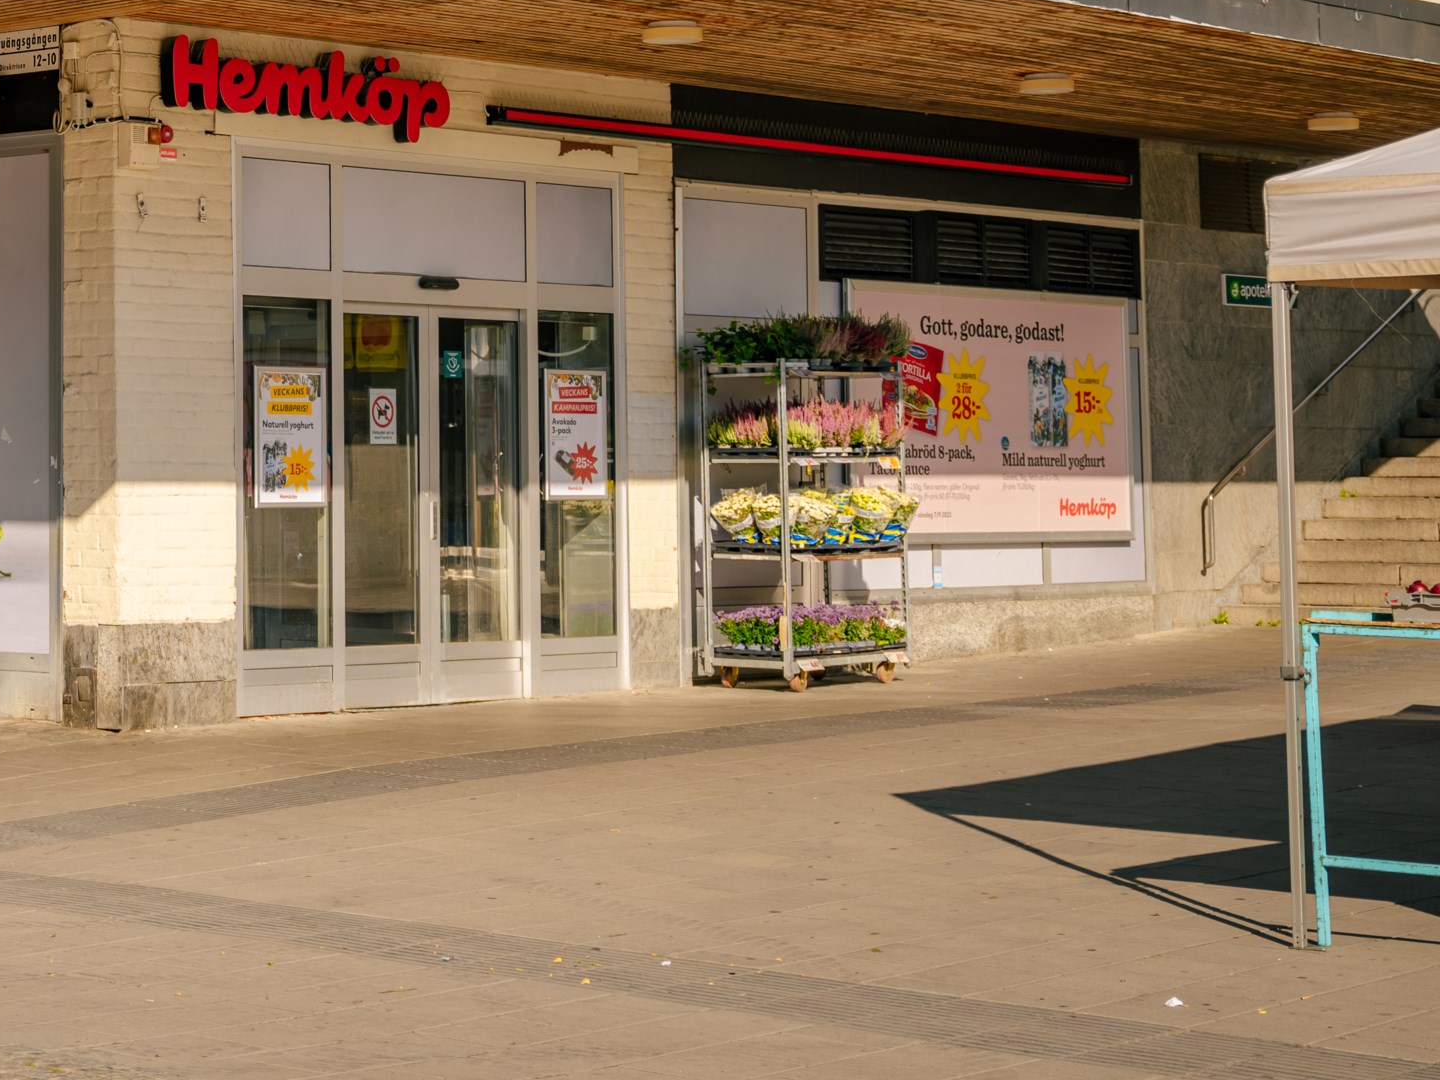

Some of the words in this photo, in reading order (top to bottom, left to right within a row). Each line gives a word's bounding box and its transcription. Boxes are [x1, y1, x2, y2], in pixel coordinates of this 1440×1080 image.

[33, 53, 57, 67] 12-10
[172, 34, 450, 143] Hemköp
[920, 315, 958, 339] Gott,
[960, 318, 1012, 344] godare,
[1015, 321, 1065, 344] godast!
[273, 387, 305, 396] VECKANS
[560, 388, 588, 397] VECKANS
[957, 383, 961, 393] 2
[961, 382, 972, 394] för
[271, 404, 309, 413] KLUBBPRIS!
[553, 403, 596, 412] KAMPANJPRIS!
[951, 395, 981, 420] 28:-
[1075, 391, 1101, 414] 15:-
[262, 420, 289, 429] Naturell
[289, 421, 314, 431] yoghurt
[552, 418, 577, 426] Avokado
[552, 426, 571, 436] 3-pack
[938, 445, 975, 462] 8-pack,
[1002, 452, 1026, 467] Mild
[1027, 452, 1066, 468] naturell
[1068, 454, 1105, 471] yoghurt
[905, 465, 930, 476] auce
[1059, 497, 1117, 520] Hemköp
